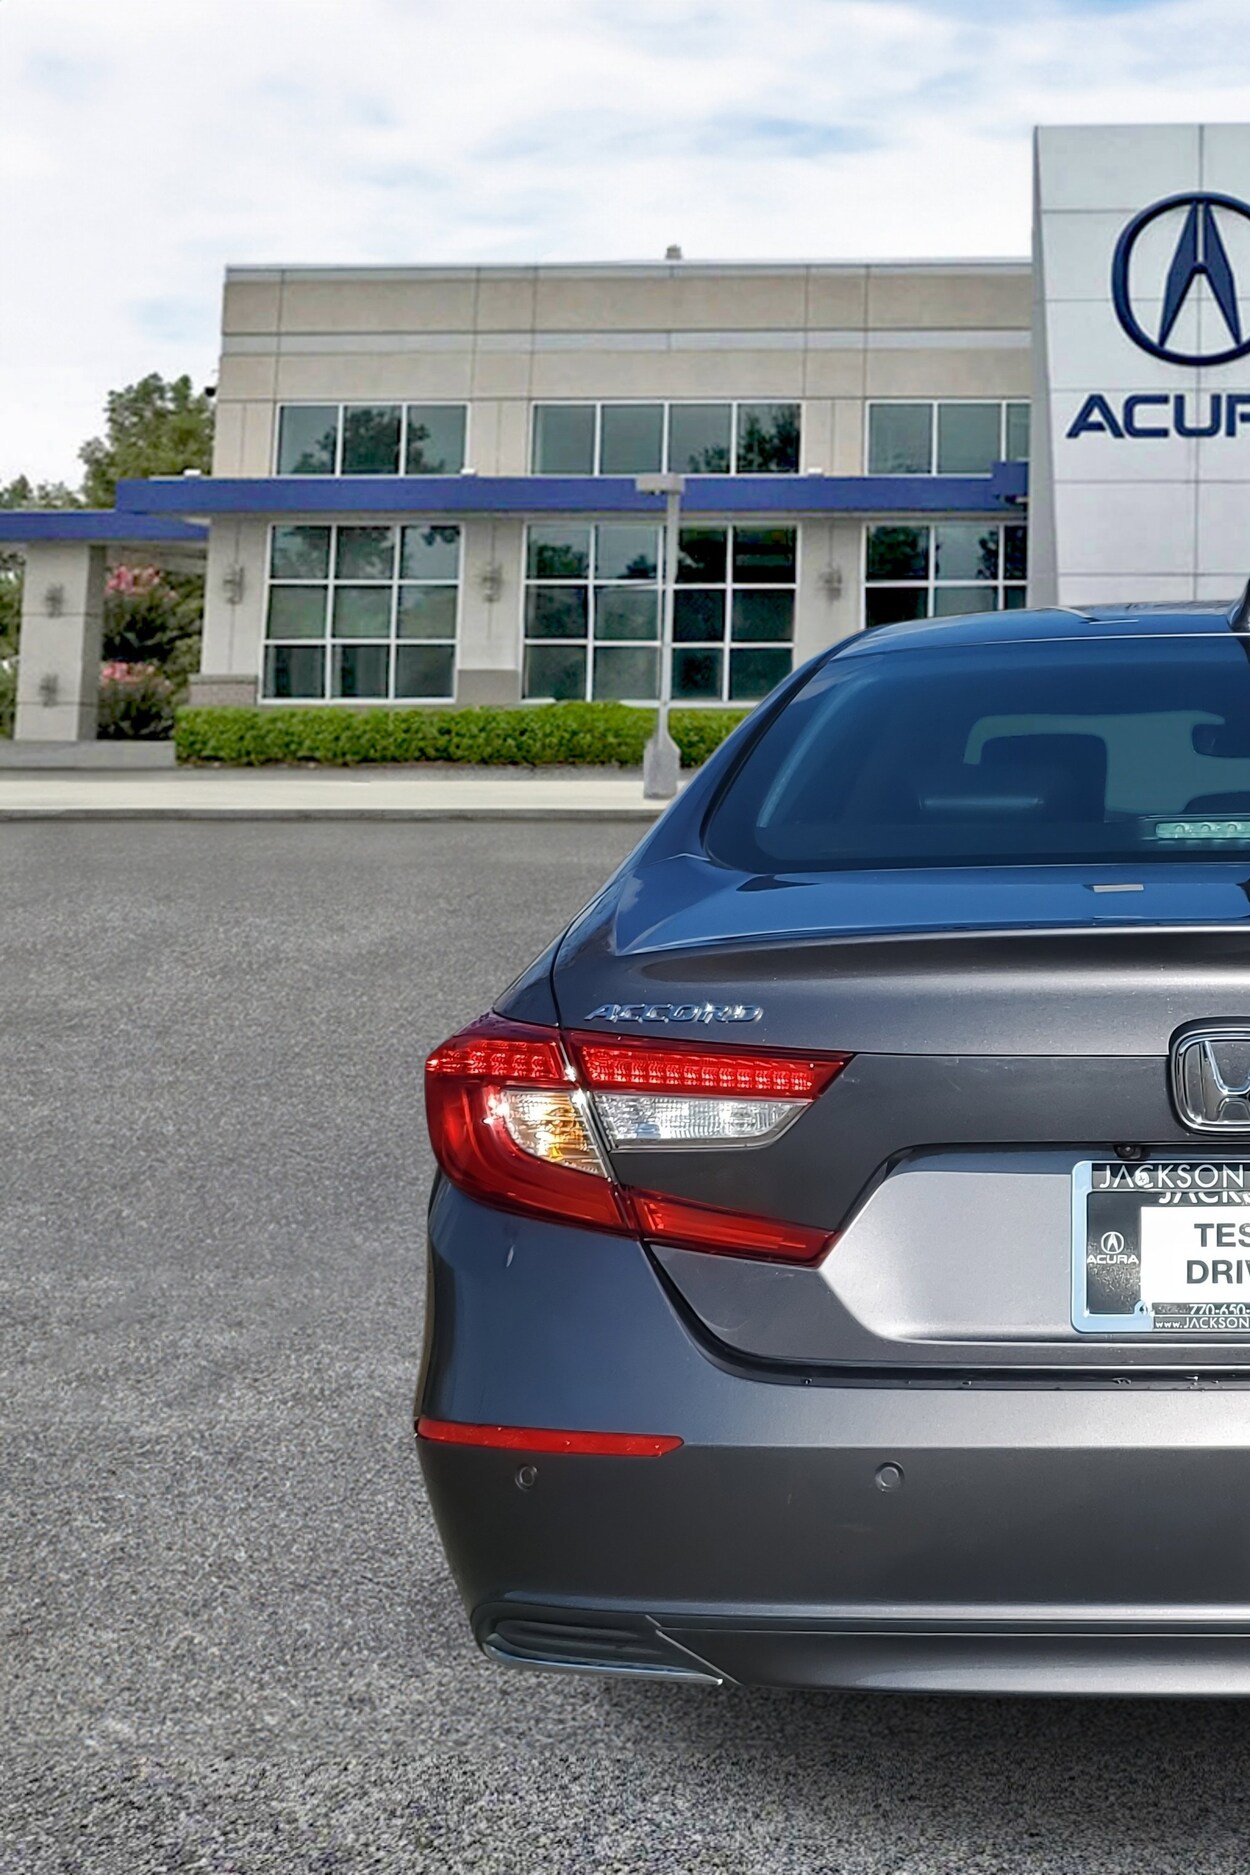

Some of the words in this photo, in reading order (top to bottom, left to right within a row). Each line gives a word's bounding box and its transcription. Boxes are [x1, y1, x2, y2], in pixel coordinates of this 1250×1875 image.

[583, 1002, 764, 1024] ACCORD
[1099, 1163, 1245, 1189] JACKSON
[1086, 1253, 1139, 1265] ACURA
